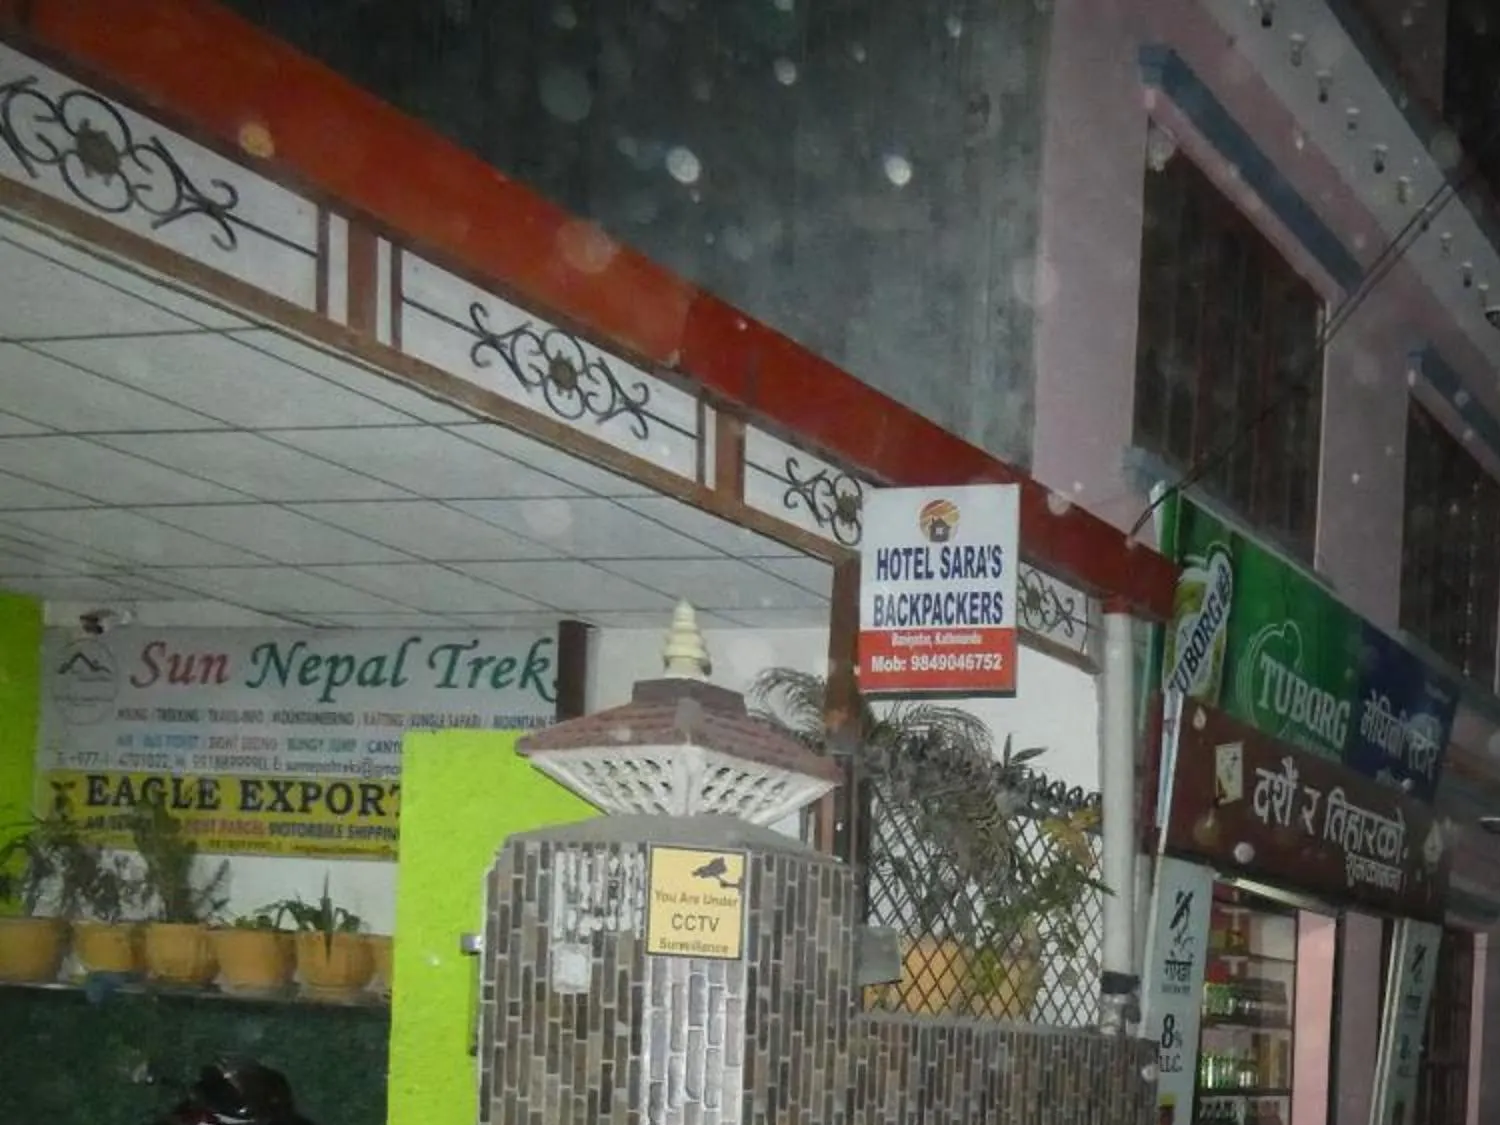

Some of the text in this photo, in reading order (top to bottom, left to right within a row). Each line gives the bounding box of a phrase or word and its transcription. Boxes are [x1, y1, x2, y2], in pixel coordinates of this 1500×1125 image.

[876, 544, 1003, 581] HOTEL SARA'S
[873, 591, 1003, 627] BACKPACKERS
[130, 636, 558, 704] Sun Nepal Trek
[871, 655, 907, 672] Mob:
[1257, 652, 1350, 749] TUBORG
[86, 775, 221, 811] EAGLE
[1302, 785, 1322, 835] र
[655, 890, 738, 908] You Are Under
[671, 913, 720, 933] CCTV
